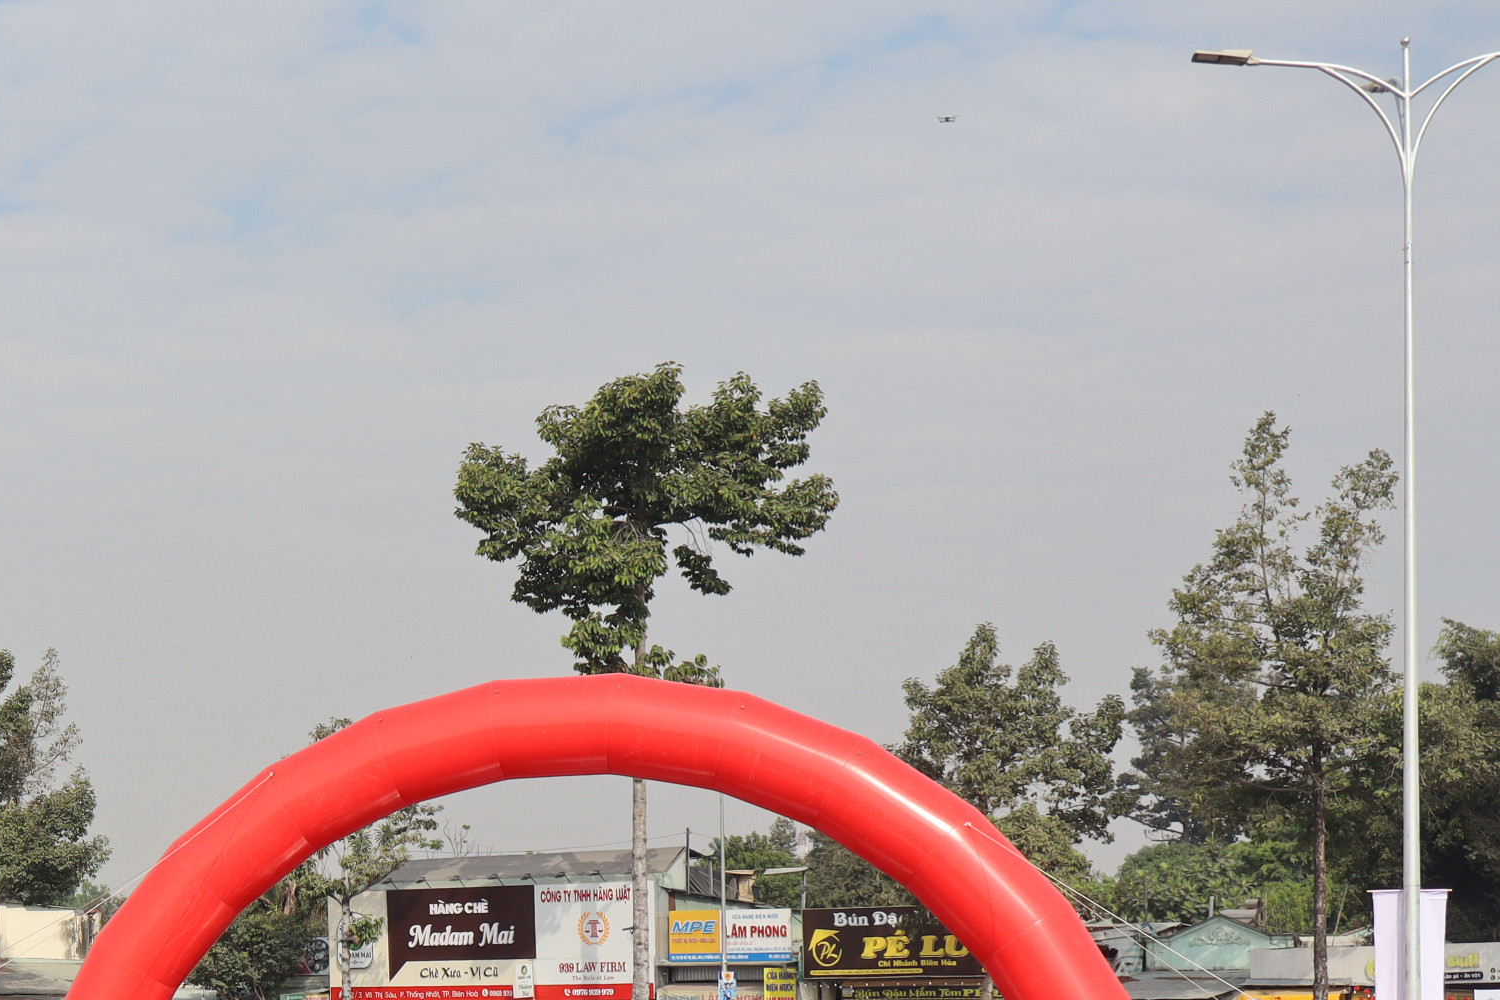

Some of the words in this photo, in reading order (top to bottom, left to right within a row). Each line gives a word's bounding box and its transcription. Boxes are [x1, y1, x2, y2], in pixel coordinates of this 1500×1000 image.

[540, 887, 561, 903] CÔNG
[563, 890, 572, 902] TY
[574, 889, 591, 902] TNHH
[593, 886, 613, 902] HÃNG
[615, 885, 631, 904] LUẬT
[429, 899, 463, 915] HÀNG
[464, 898, 488, 914] CHÈ
[671, 920, 717, 934] MPE
[833, 911, 869, 927] Bún
[872, 911, 903, 928] Đậ
[408, 923, 474, 948] Madam
[478, 922, 515, 947] Mai
[750, 925, 787, 938] PHONG
[420, 967, 439, 979] Chè
[442, 967, 461, 980] Xưa
[469, 966, 482, 980] Vị
[483, 966, 498, 978] Cũ
[559, 962, 574, 973] 939
[576, 961, 597, 973] LAW
[600, 961, 627, 972] FIRM
